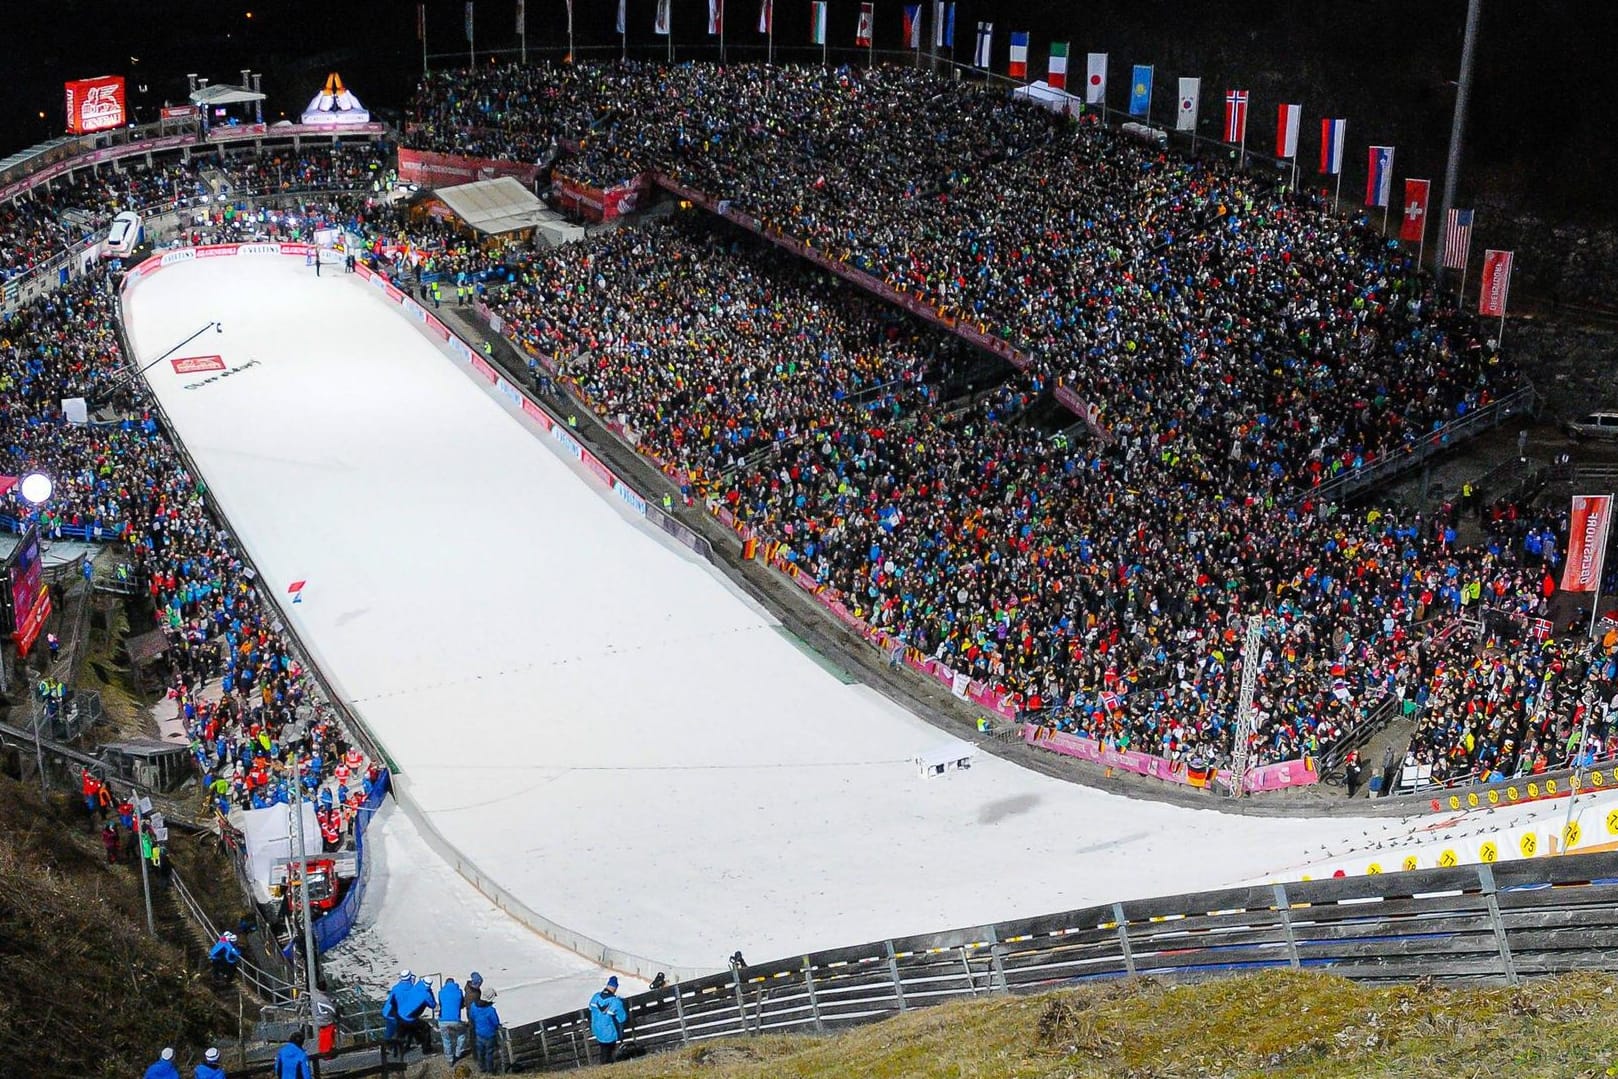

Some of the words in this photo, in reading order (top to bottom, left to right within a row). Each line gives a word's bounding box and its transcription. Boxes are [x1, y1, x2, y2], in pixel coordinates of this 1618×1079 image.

[1523, 837, 1536, 853] 75
[1443, 854, 1455, 867] 77
[1482, 846, 1495, 861] 76
